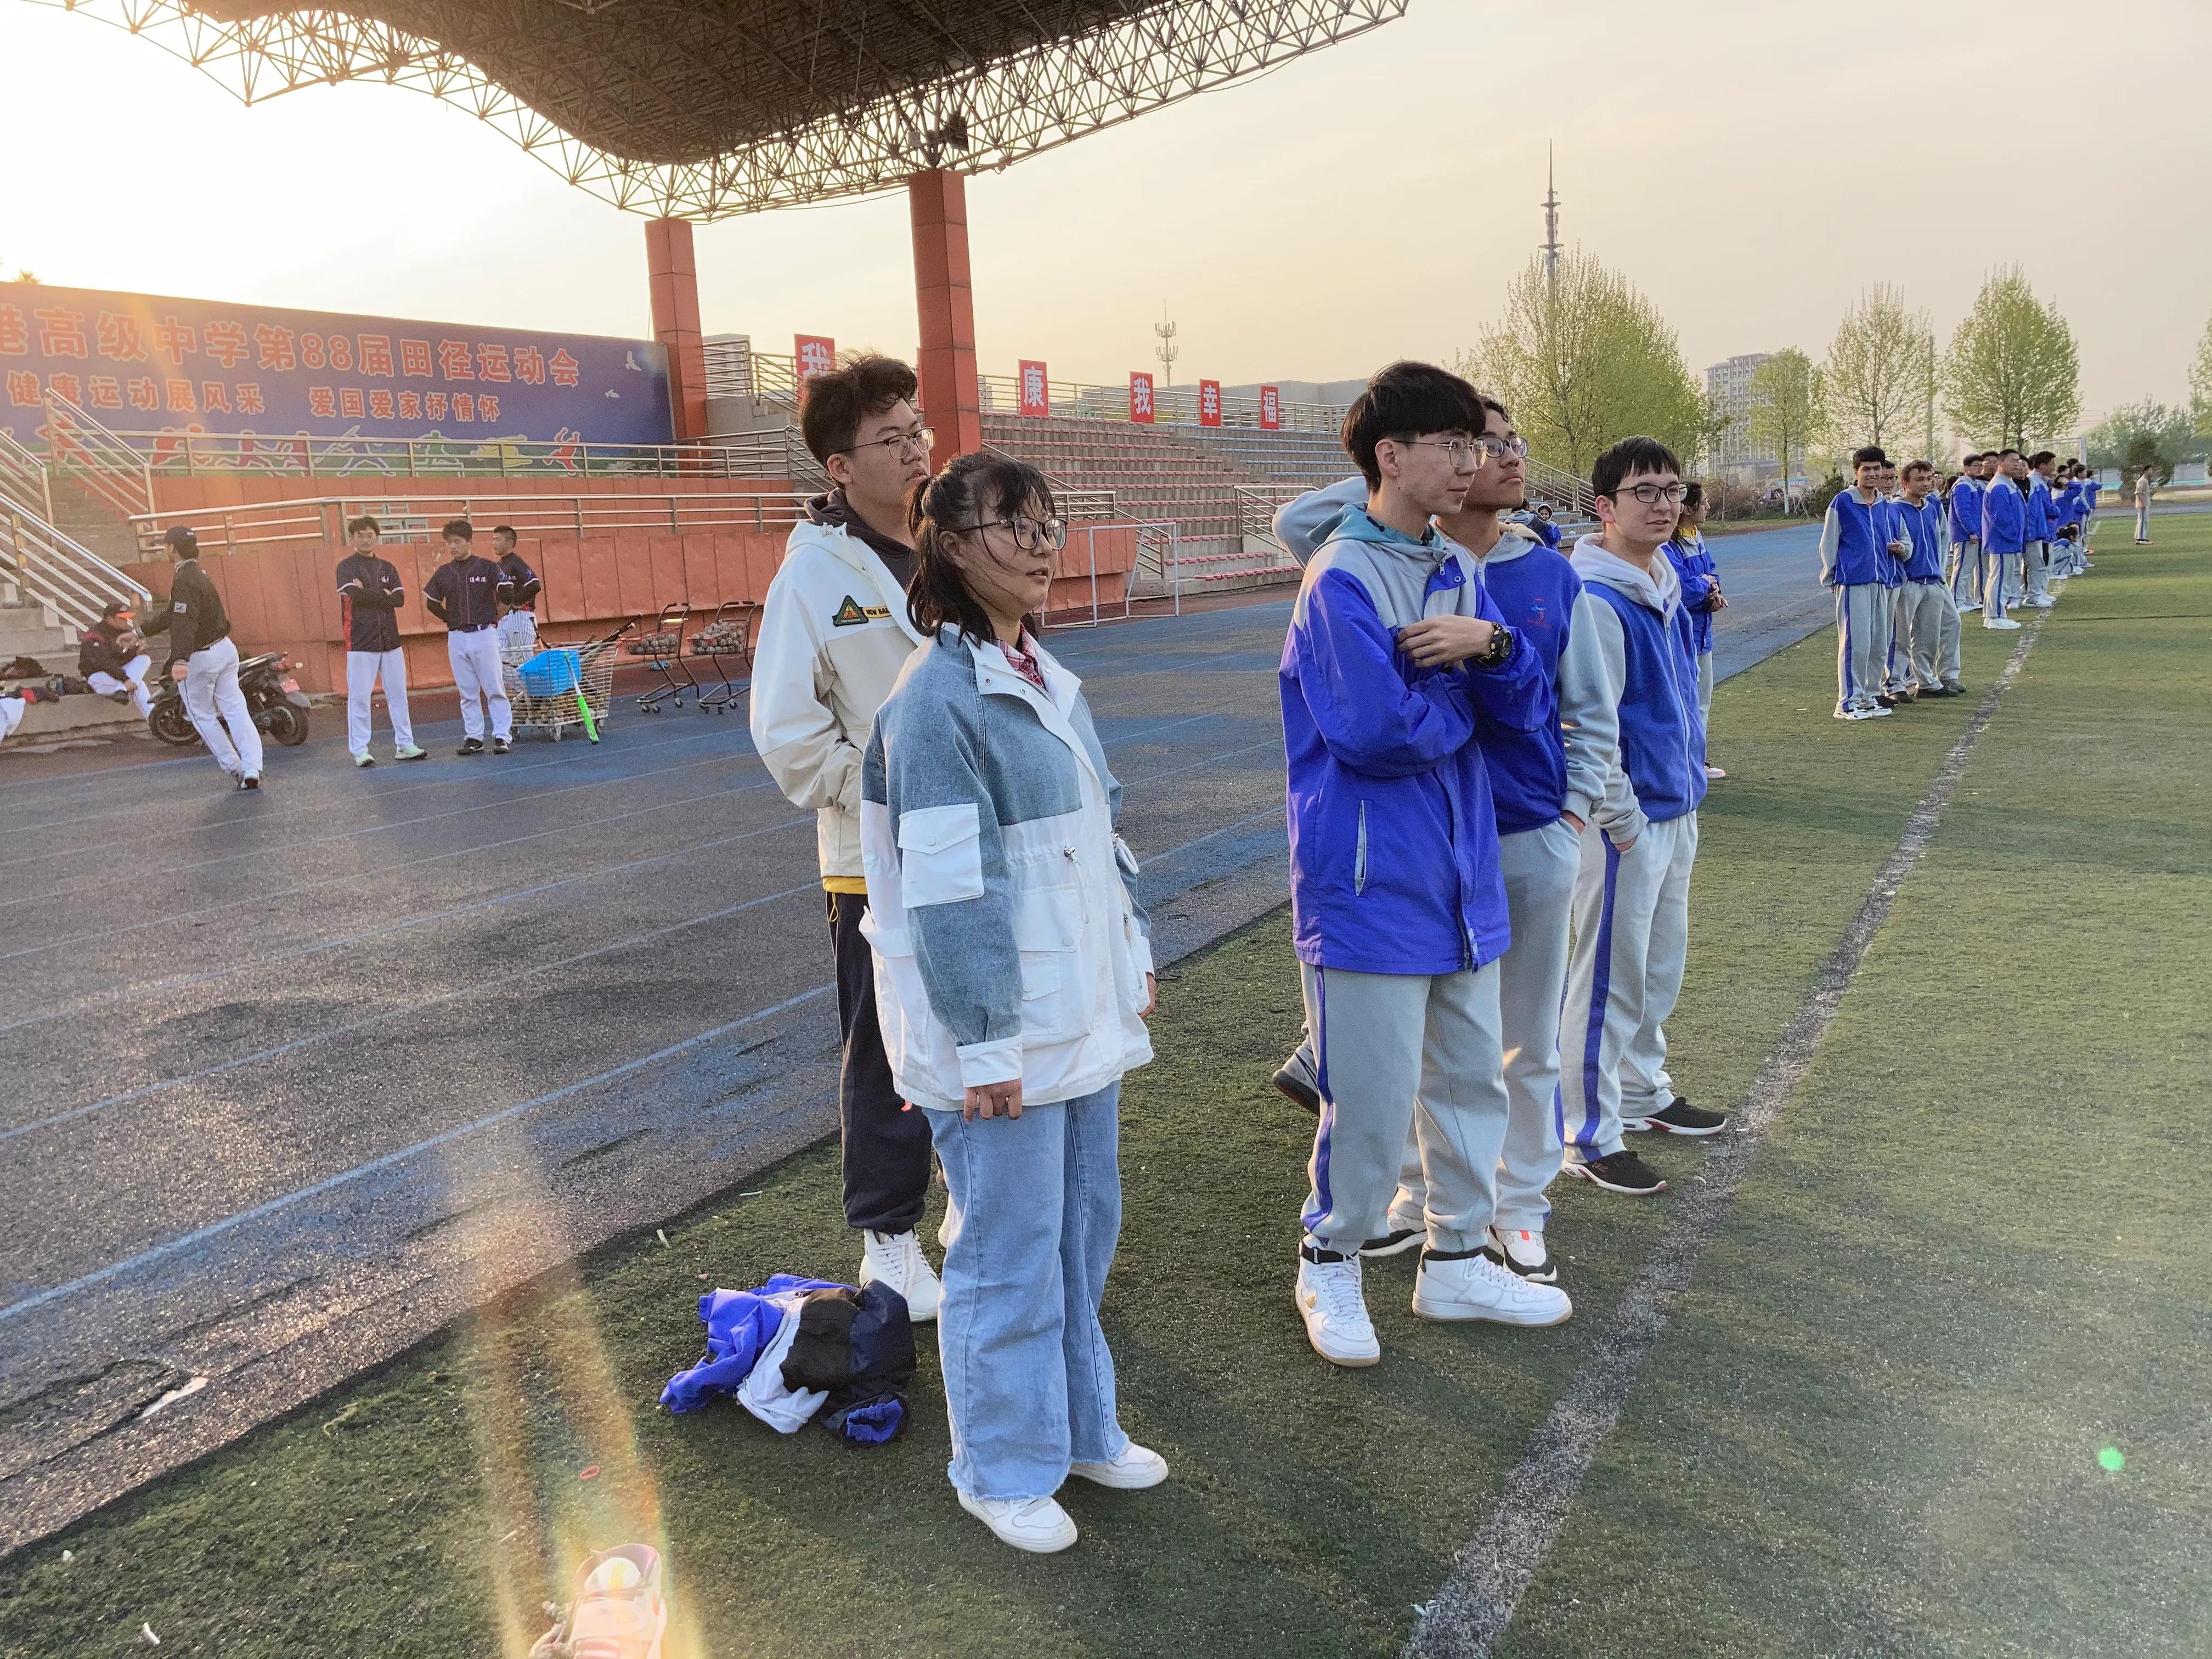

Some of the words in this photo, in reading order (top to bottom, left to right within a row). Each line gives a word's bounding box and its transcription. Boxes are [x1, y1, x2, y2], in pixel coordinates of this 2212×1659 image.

[801, 342, 831, 377] 我
[7, 370, 266, 415] 健康运动展风采
[309, 385, 501, 422] 爱国爱家抒情怀
[1023, 365, 1045, 408] 康
[1133, 376, 1152, 415] 我
[1203, 384, 1218, 419] 幸
[1263, 390, 1277, 424] 福
